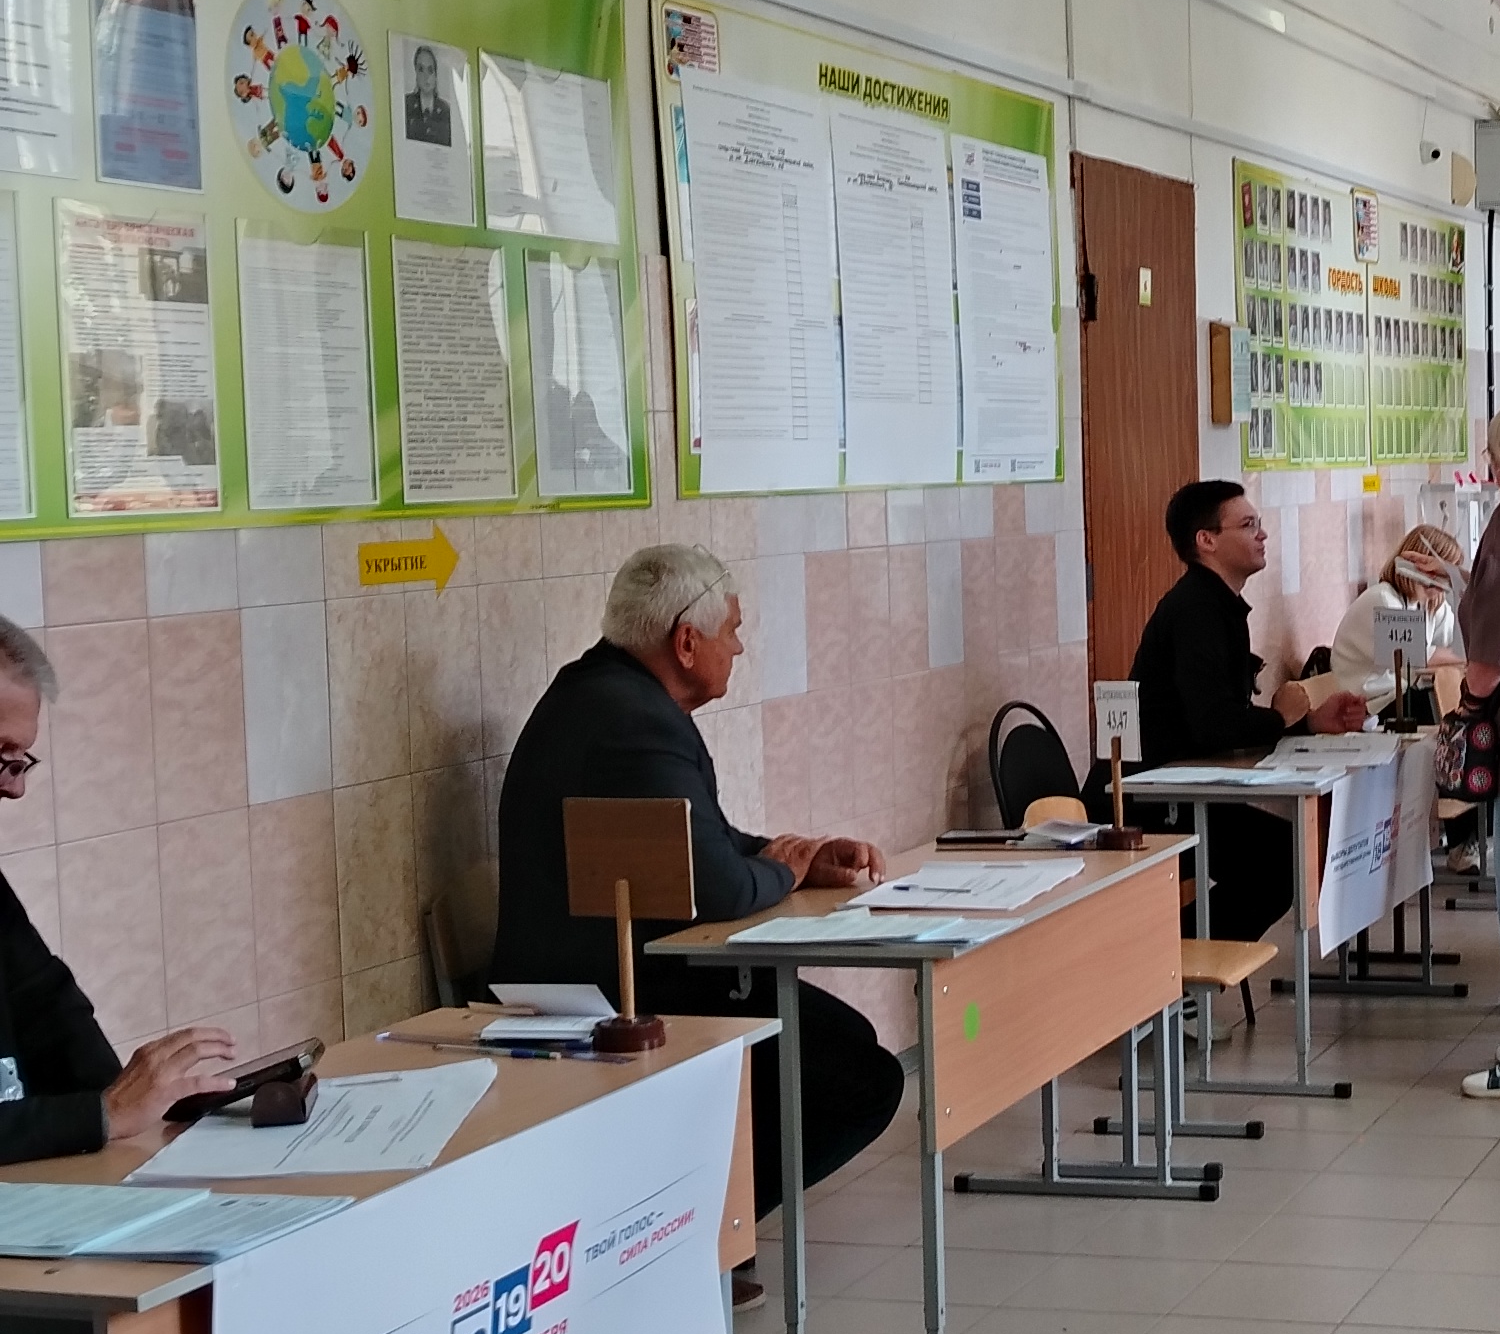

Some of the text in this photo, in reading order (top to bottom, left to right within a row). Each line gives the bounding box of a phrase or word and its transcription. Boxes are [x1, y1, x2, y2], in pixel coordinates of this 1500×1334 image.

[818, 62, 949, 119] НАШИ ДОСТИЖЕНИЯ
[1328, 267, 1401, 298] ГОРДОСТЬ ШКОЛЫ
[365, 555, 427, 575] УКРЫТИЕ
[1389, 629, 1412, 643] 41,42
[584, 1230, 616, 1265] ТВОЙ
[619, 1207, 696, 1266] СИЛА РОССИИ!
[532, 1241, 571, 1295] 20
[453, 1279, 490, 1314] 2026
